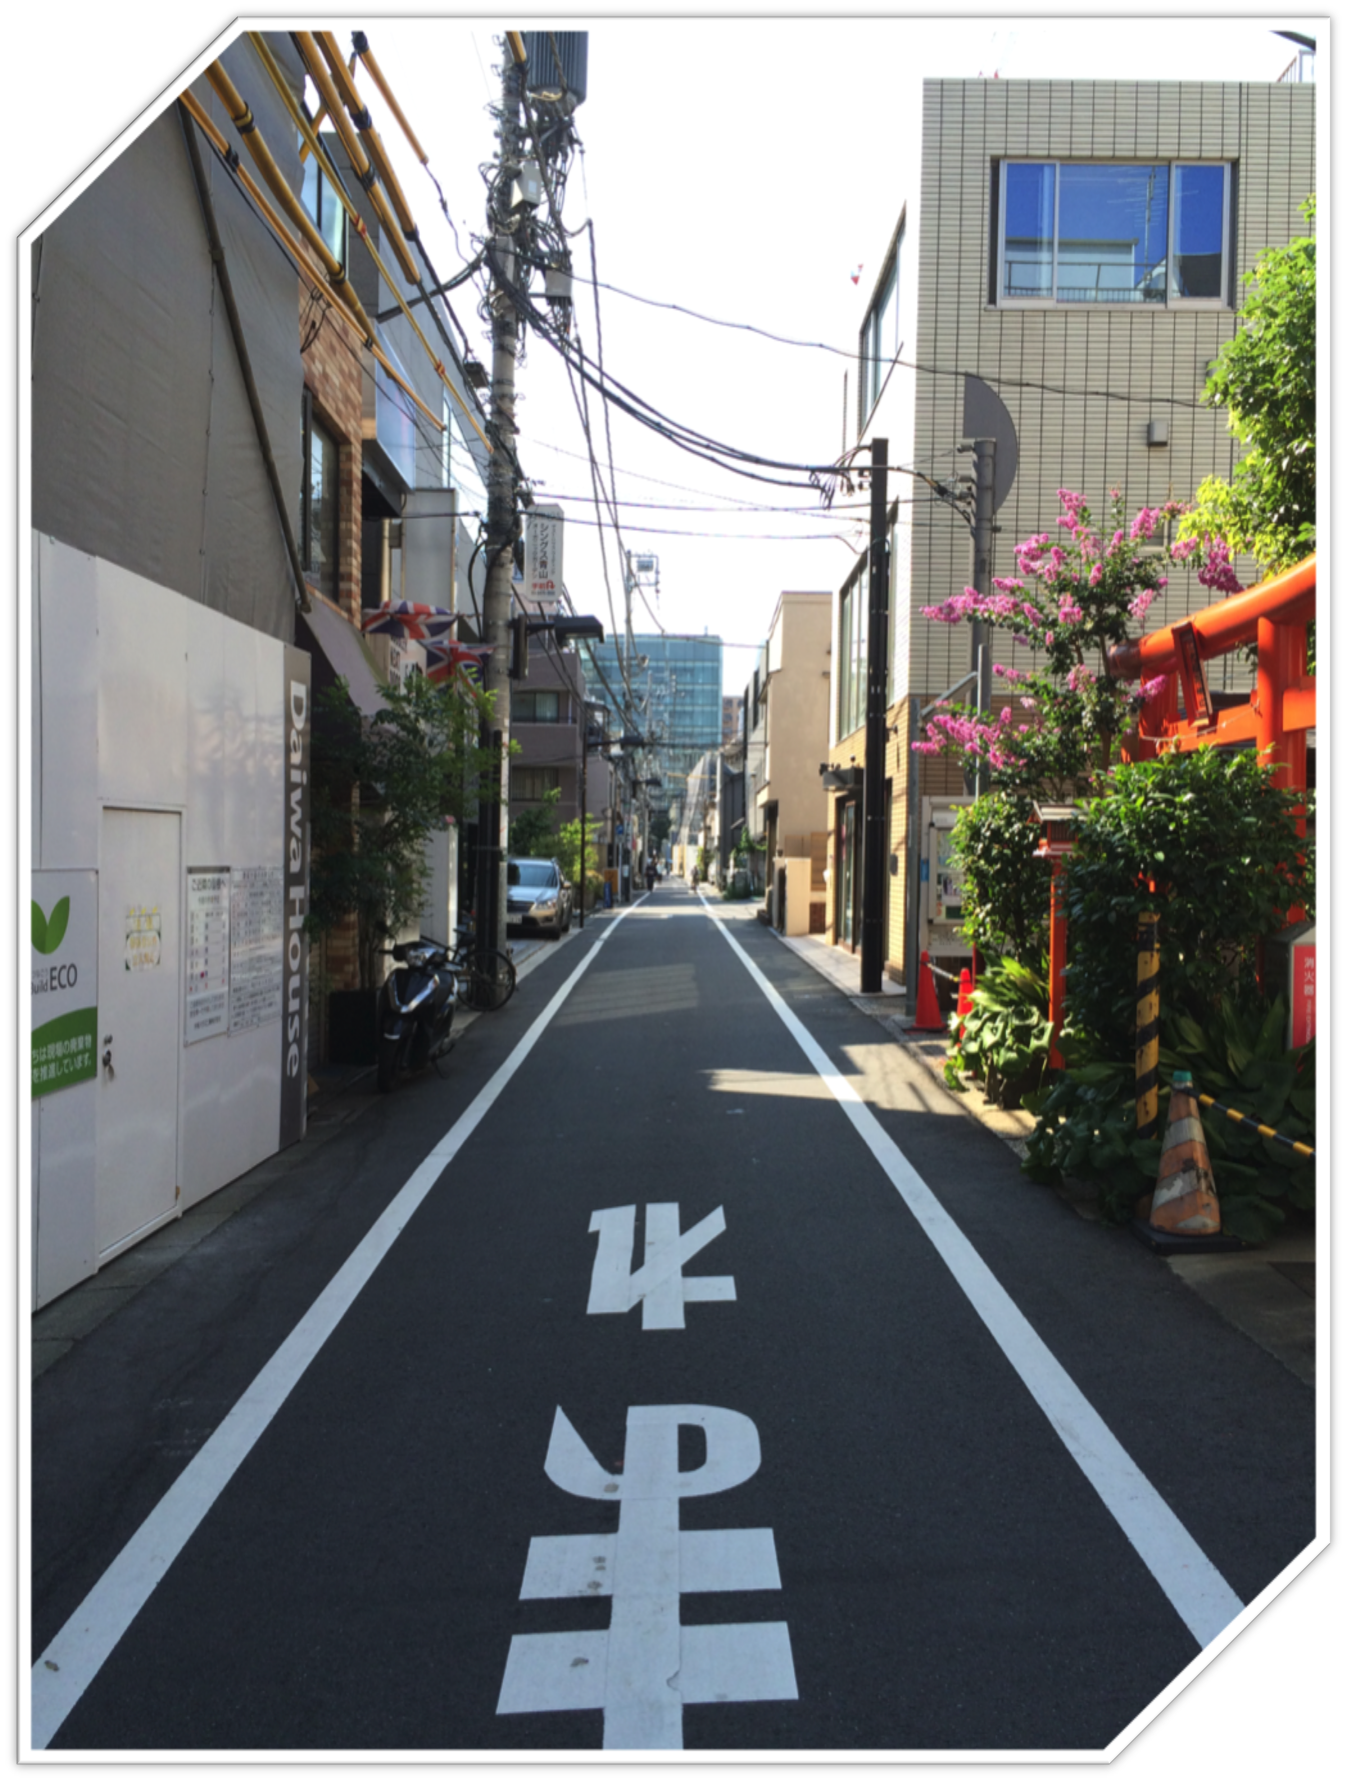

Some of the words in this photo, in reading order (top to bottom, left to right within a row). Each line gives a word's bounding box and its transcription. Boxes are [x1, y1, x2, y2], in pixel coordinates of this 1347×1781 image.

[539, 523, 549, 578] シングス青山
[288, 680, 307, 874] Daiwa
[49, 963, 78, 991] ECO
[286, 884, 305, 1078] House
[1304, 957, 1314, 996] 消火器
